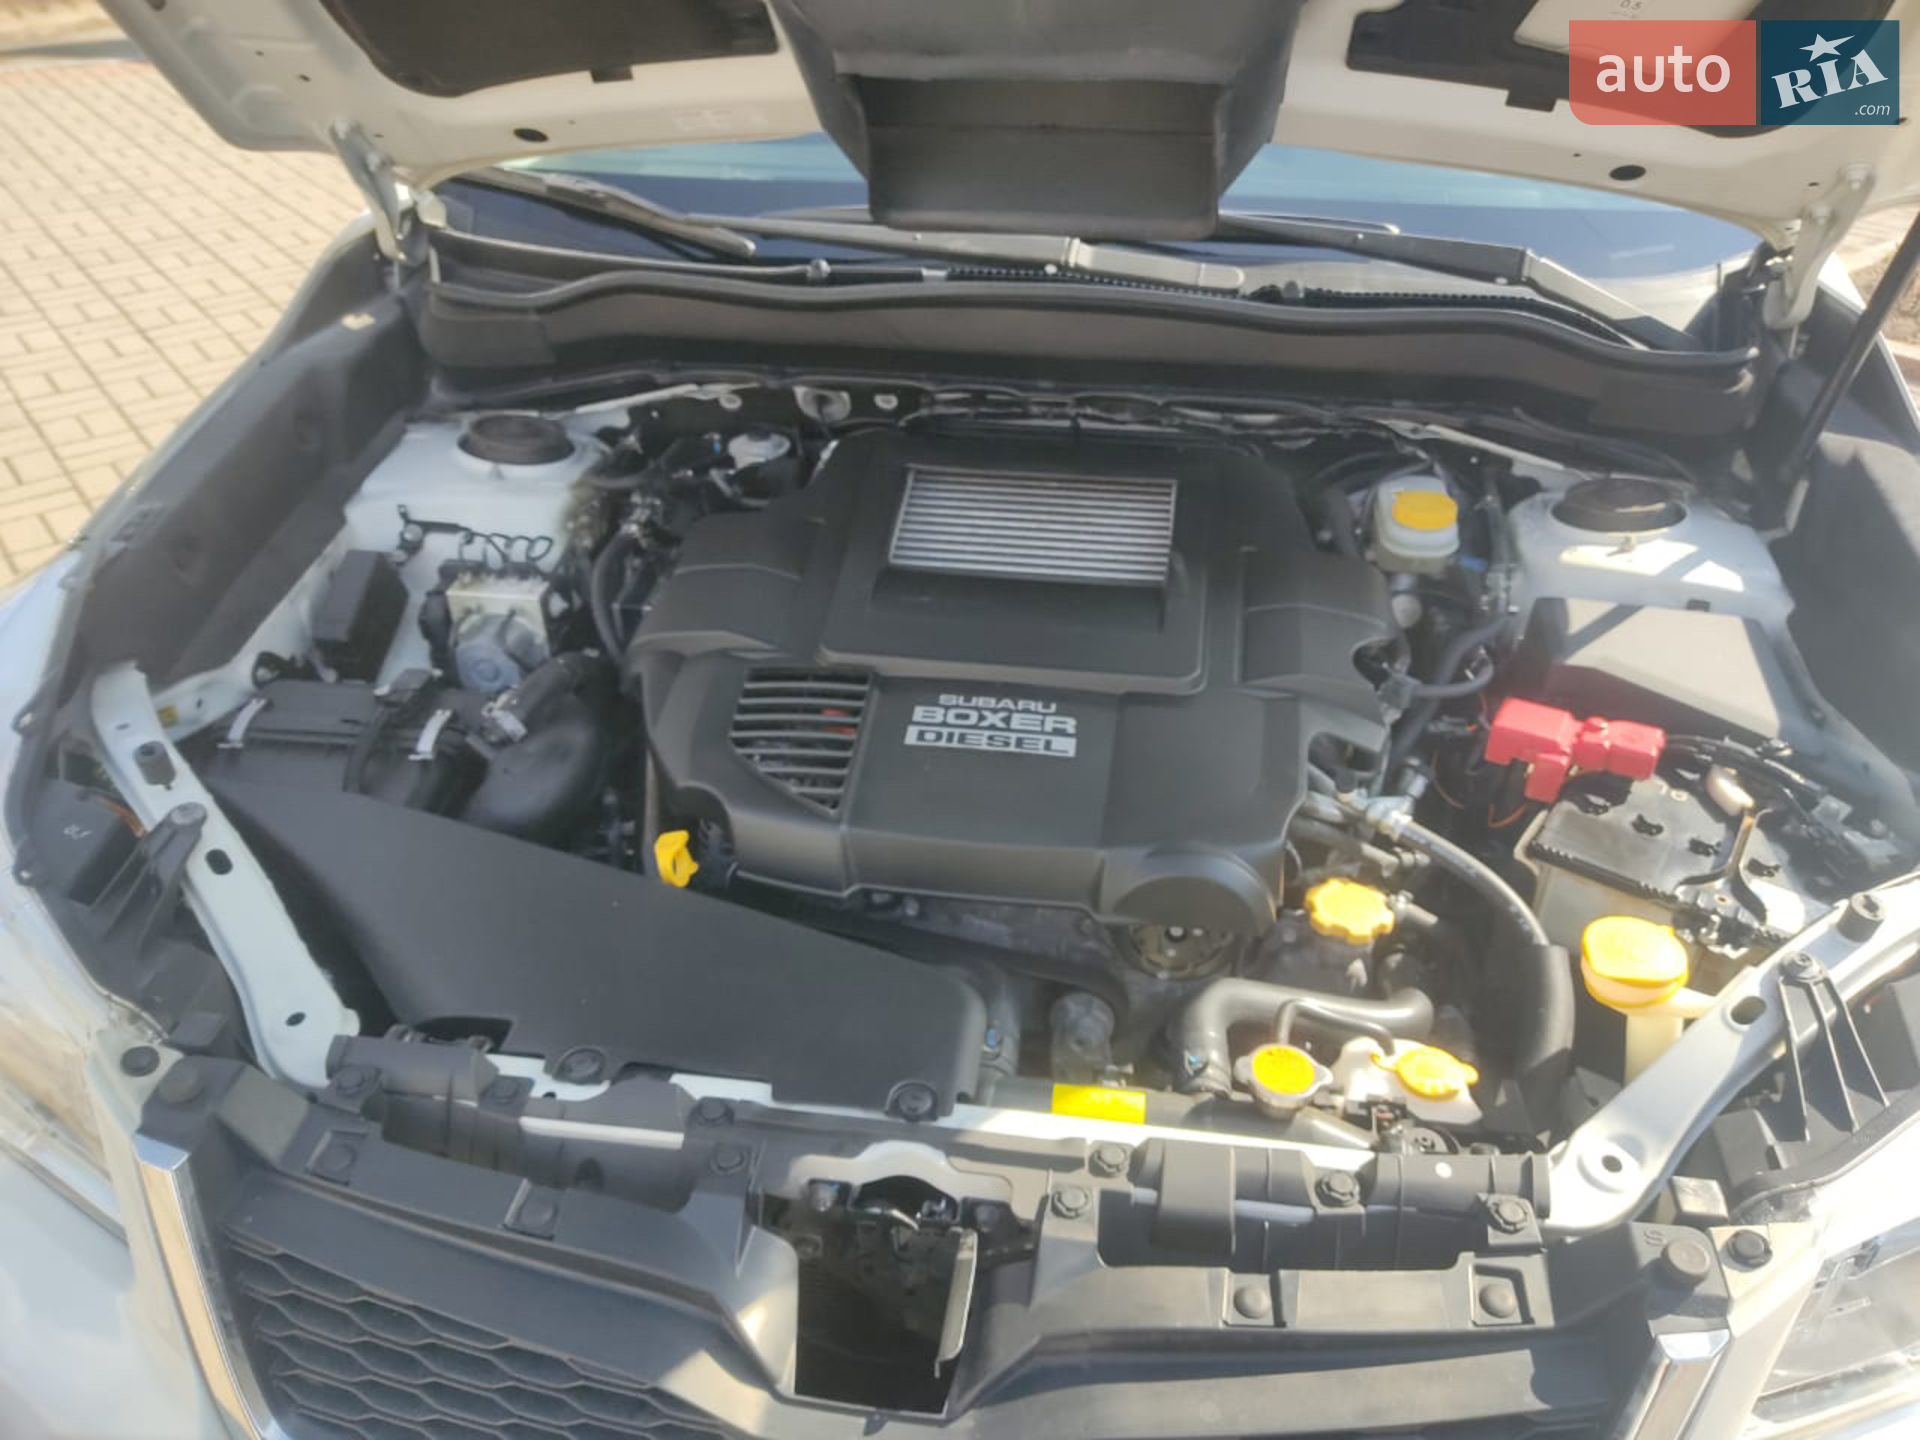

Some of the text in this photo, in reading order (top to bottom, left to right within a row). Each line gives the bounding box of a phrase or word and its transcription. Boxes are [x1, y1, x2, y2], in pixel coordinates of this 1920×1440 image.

[938, 693, 1057, 712] SUBARU
[911, 705, 1077, 734] BOXER
[915, 729, 1070, 754] DIESEL
